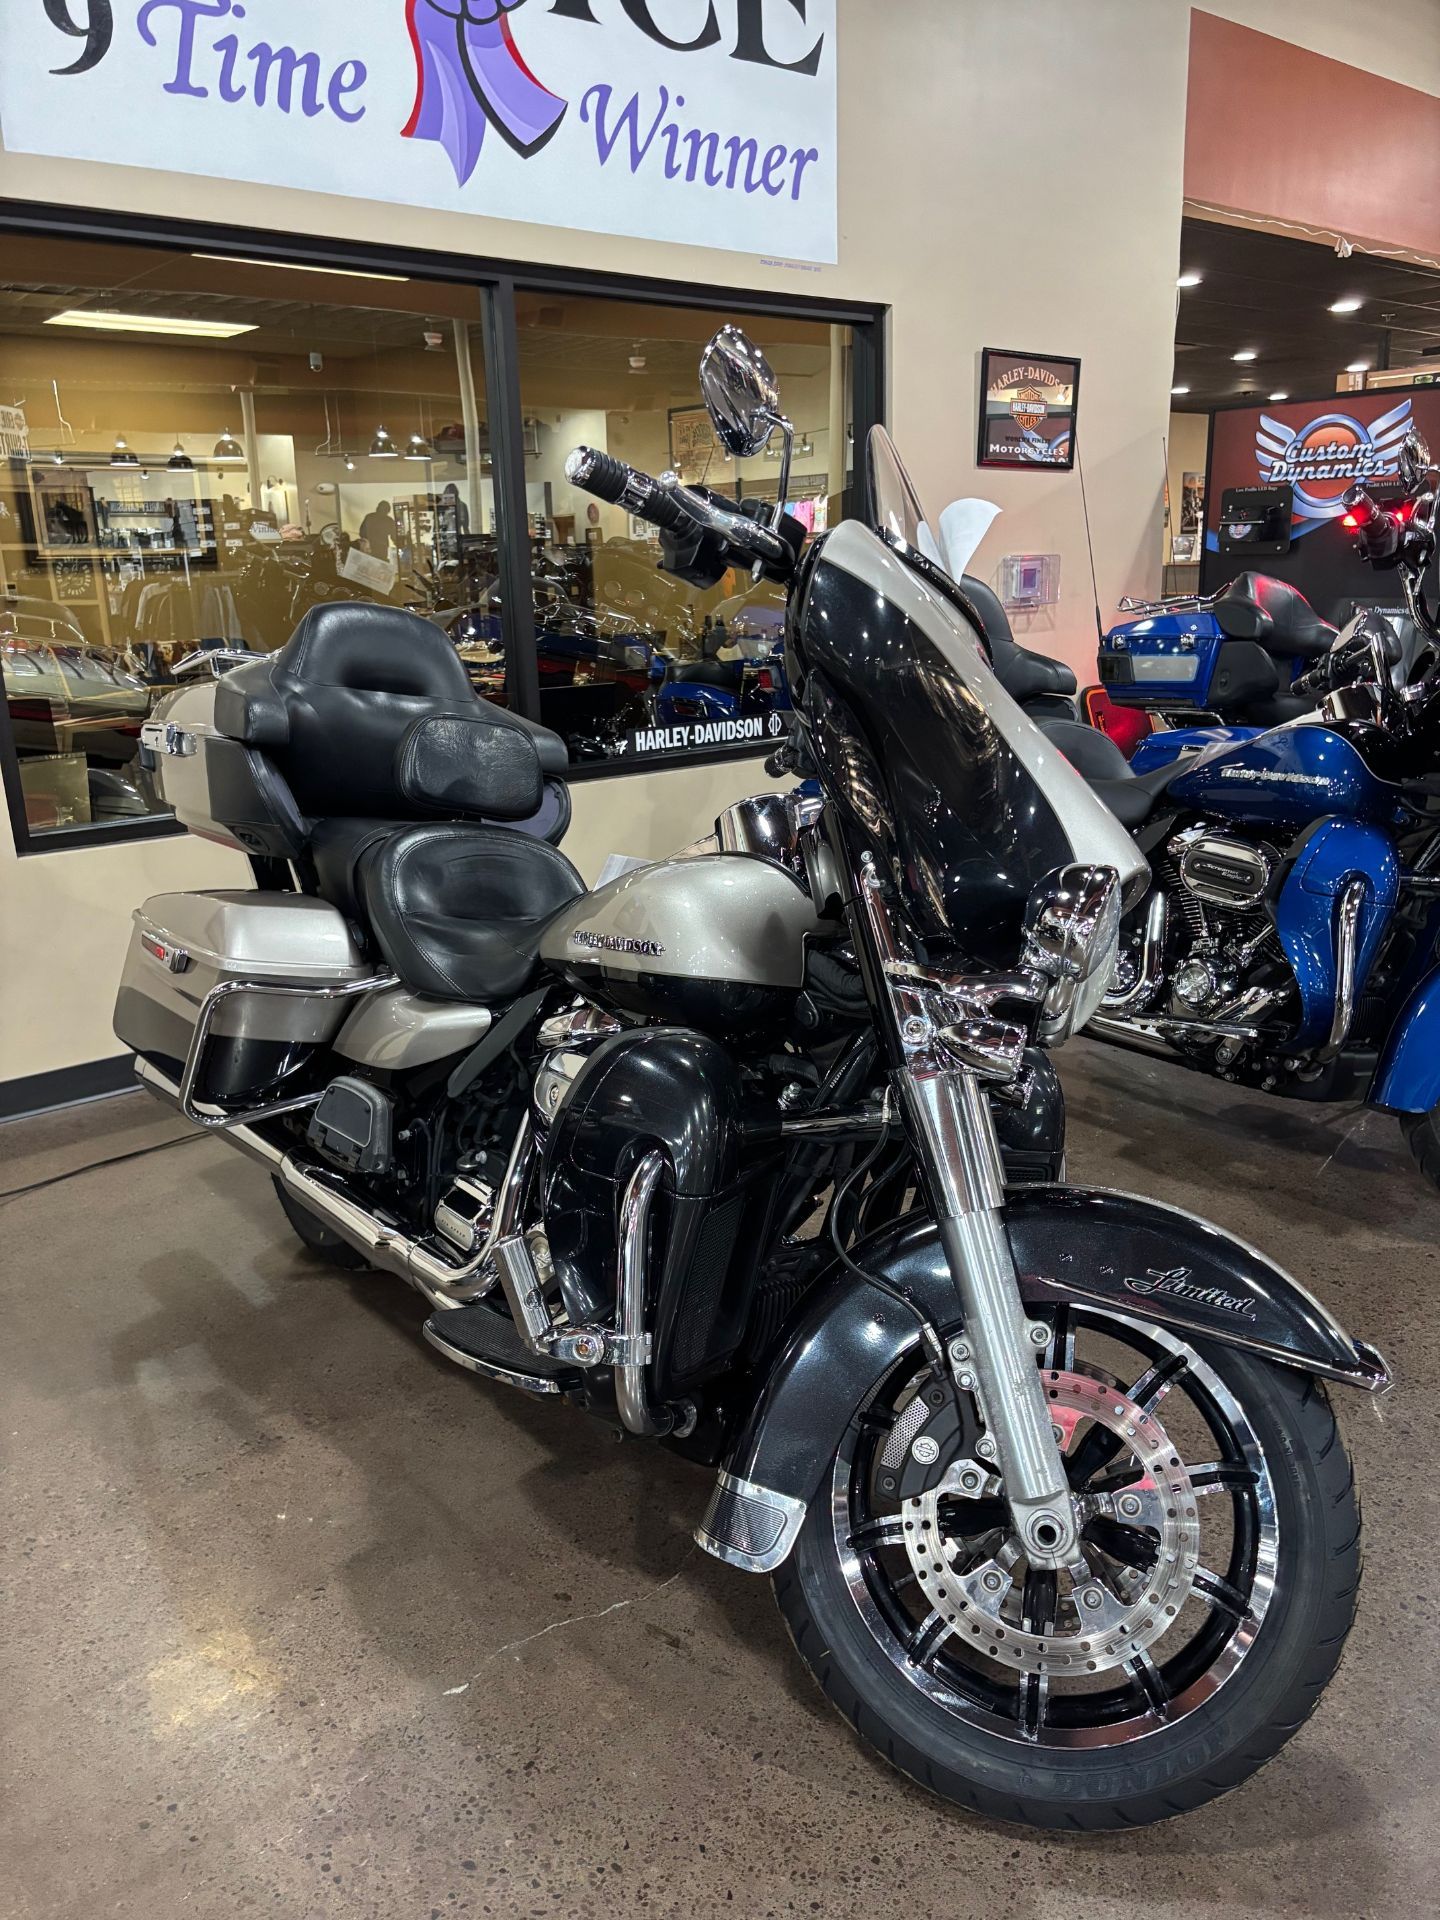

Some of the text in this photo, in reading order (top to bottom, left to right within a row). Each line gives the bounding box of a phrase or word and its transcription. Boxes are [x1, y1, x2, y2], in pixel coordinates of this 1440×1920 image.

[137, 0, 367, 123] Time
[579, 84, 819, 200] Winner
[1269, 457, 1397, 485] Dynamics
[1284, 440, 1376, 464] Custom
[635, 717, 763, 752] HARLEY-DAVIDSON
[1124, 1267, 1256, 1321] Limited
